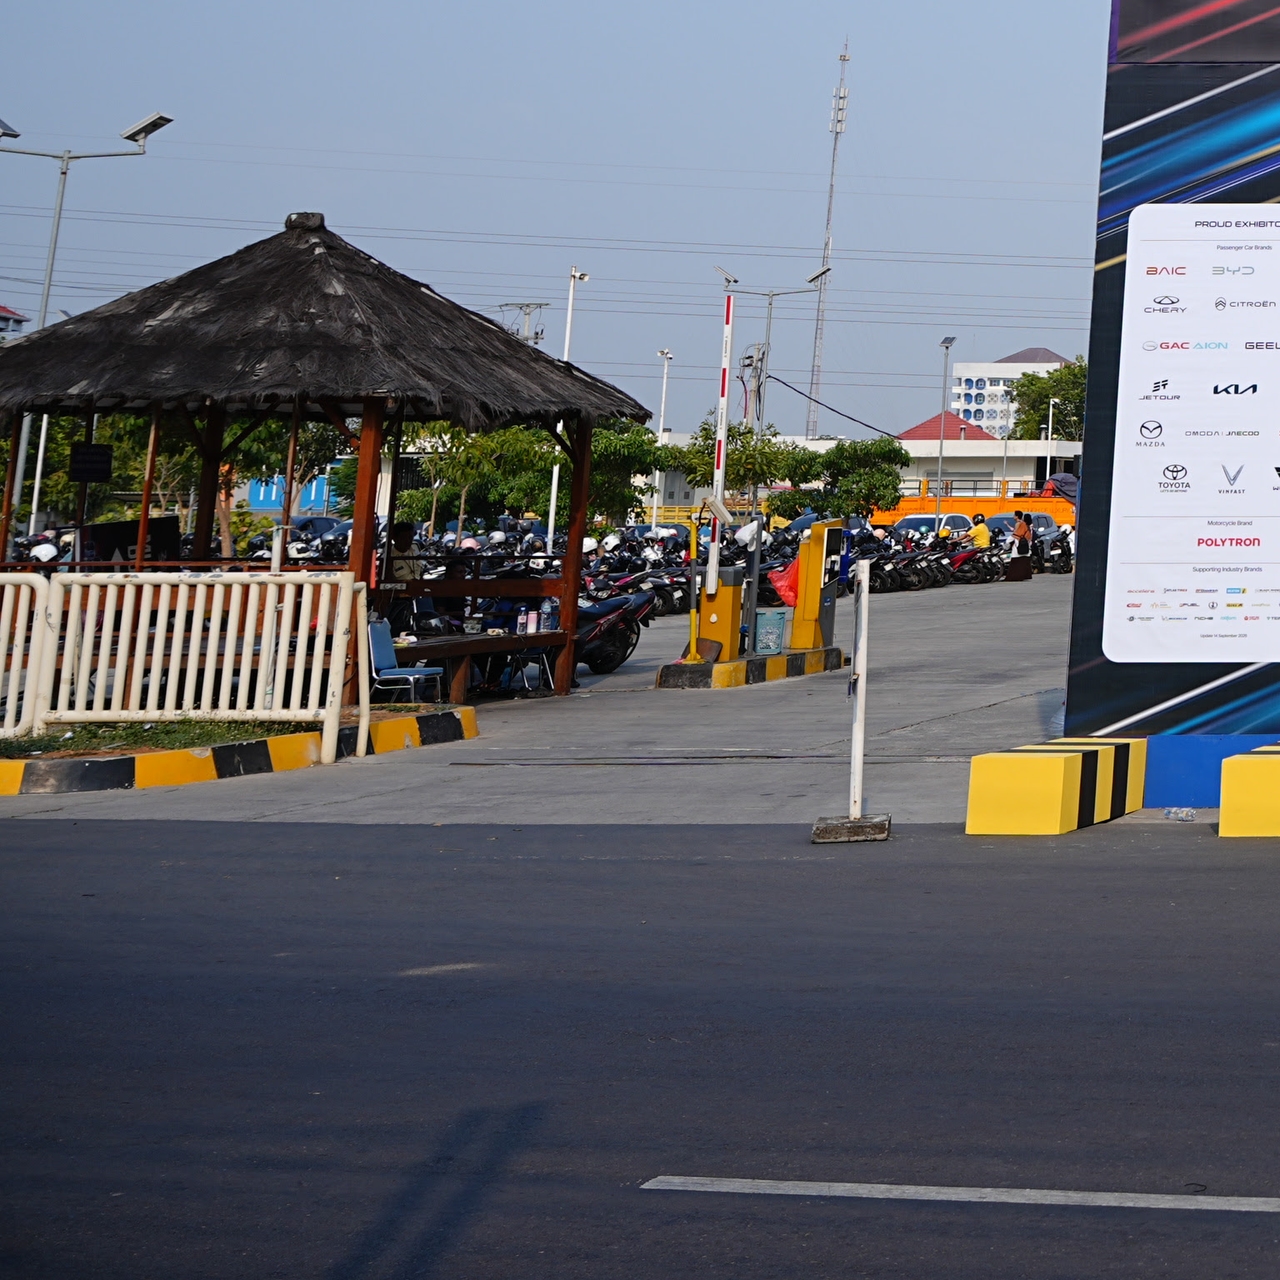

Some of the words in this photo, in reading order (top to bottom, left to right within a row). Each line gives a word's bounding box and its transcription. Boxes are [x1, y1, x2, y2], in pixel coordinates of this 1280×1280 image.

[1195, 220, 1232, 228] PROUD
[1146, 266, 1186, 275] BAIC
[1212, 266, 1255, 275] BYD
[1160, 342, 1190, 350] GAC
[1192, 342, 1228, 350] AION
[1197, 538, 1260, 547] POLYTRON
